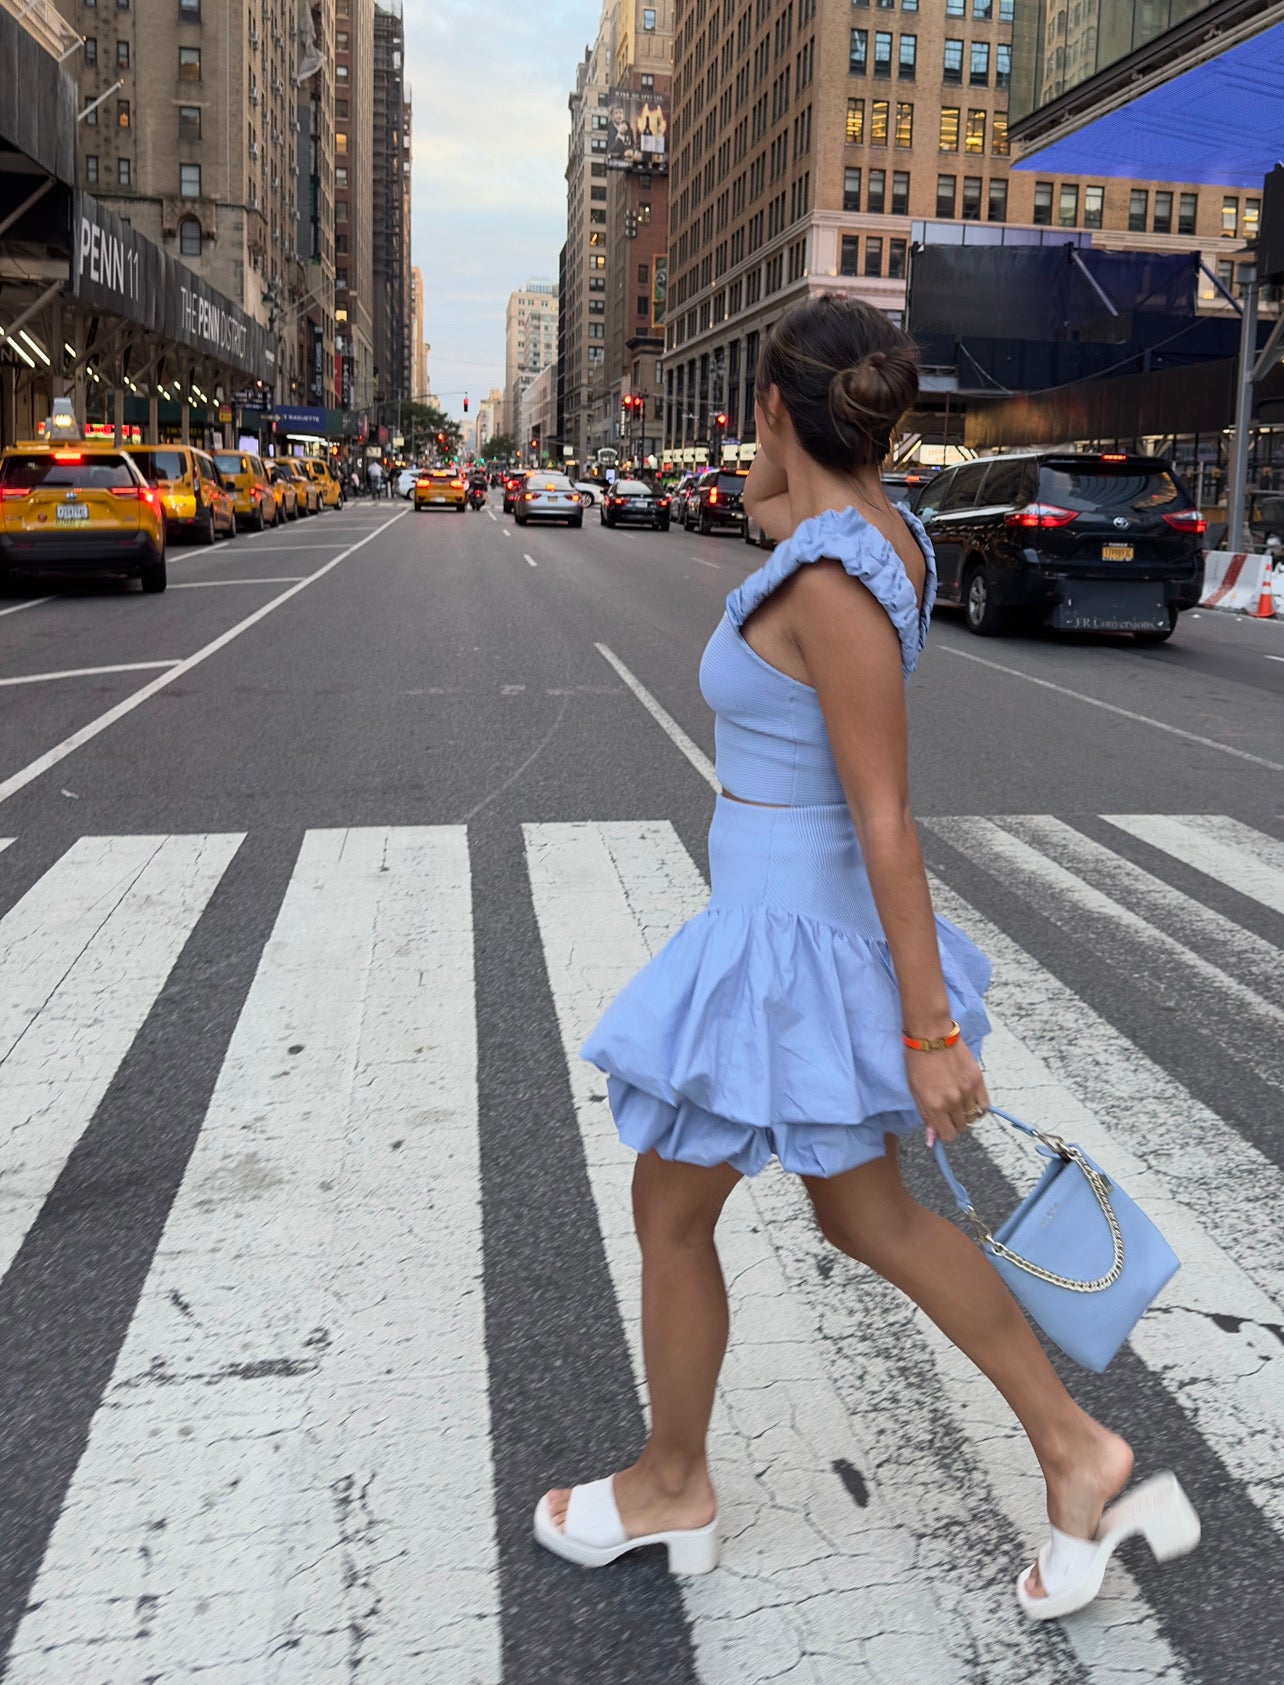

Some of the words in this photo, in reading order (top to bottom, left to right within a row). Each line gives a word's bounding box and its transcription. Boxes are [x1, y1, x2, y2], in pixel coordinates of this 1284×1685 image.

[80, 217, 124, 295] PENN
[127, 248, 139, 301] 11
[180, 286, 198, 334] THE
[198, 297, 219, 344] PENN
[221, 311, 247, 359] DISTRICT
[1092, 617, 1157, 630] Conversions
